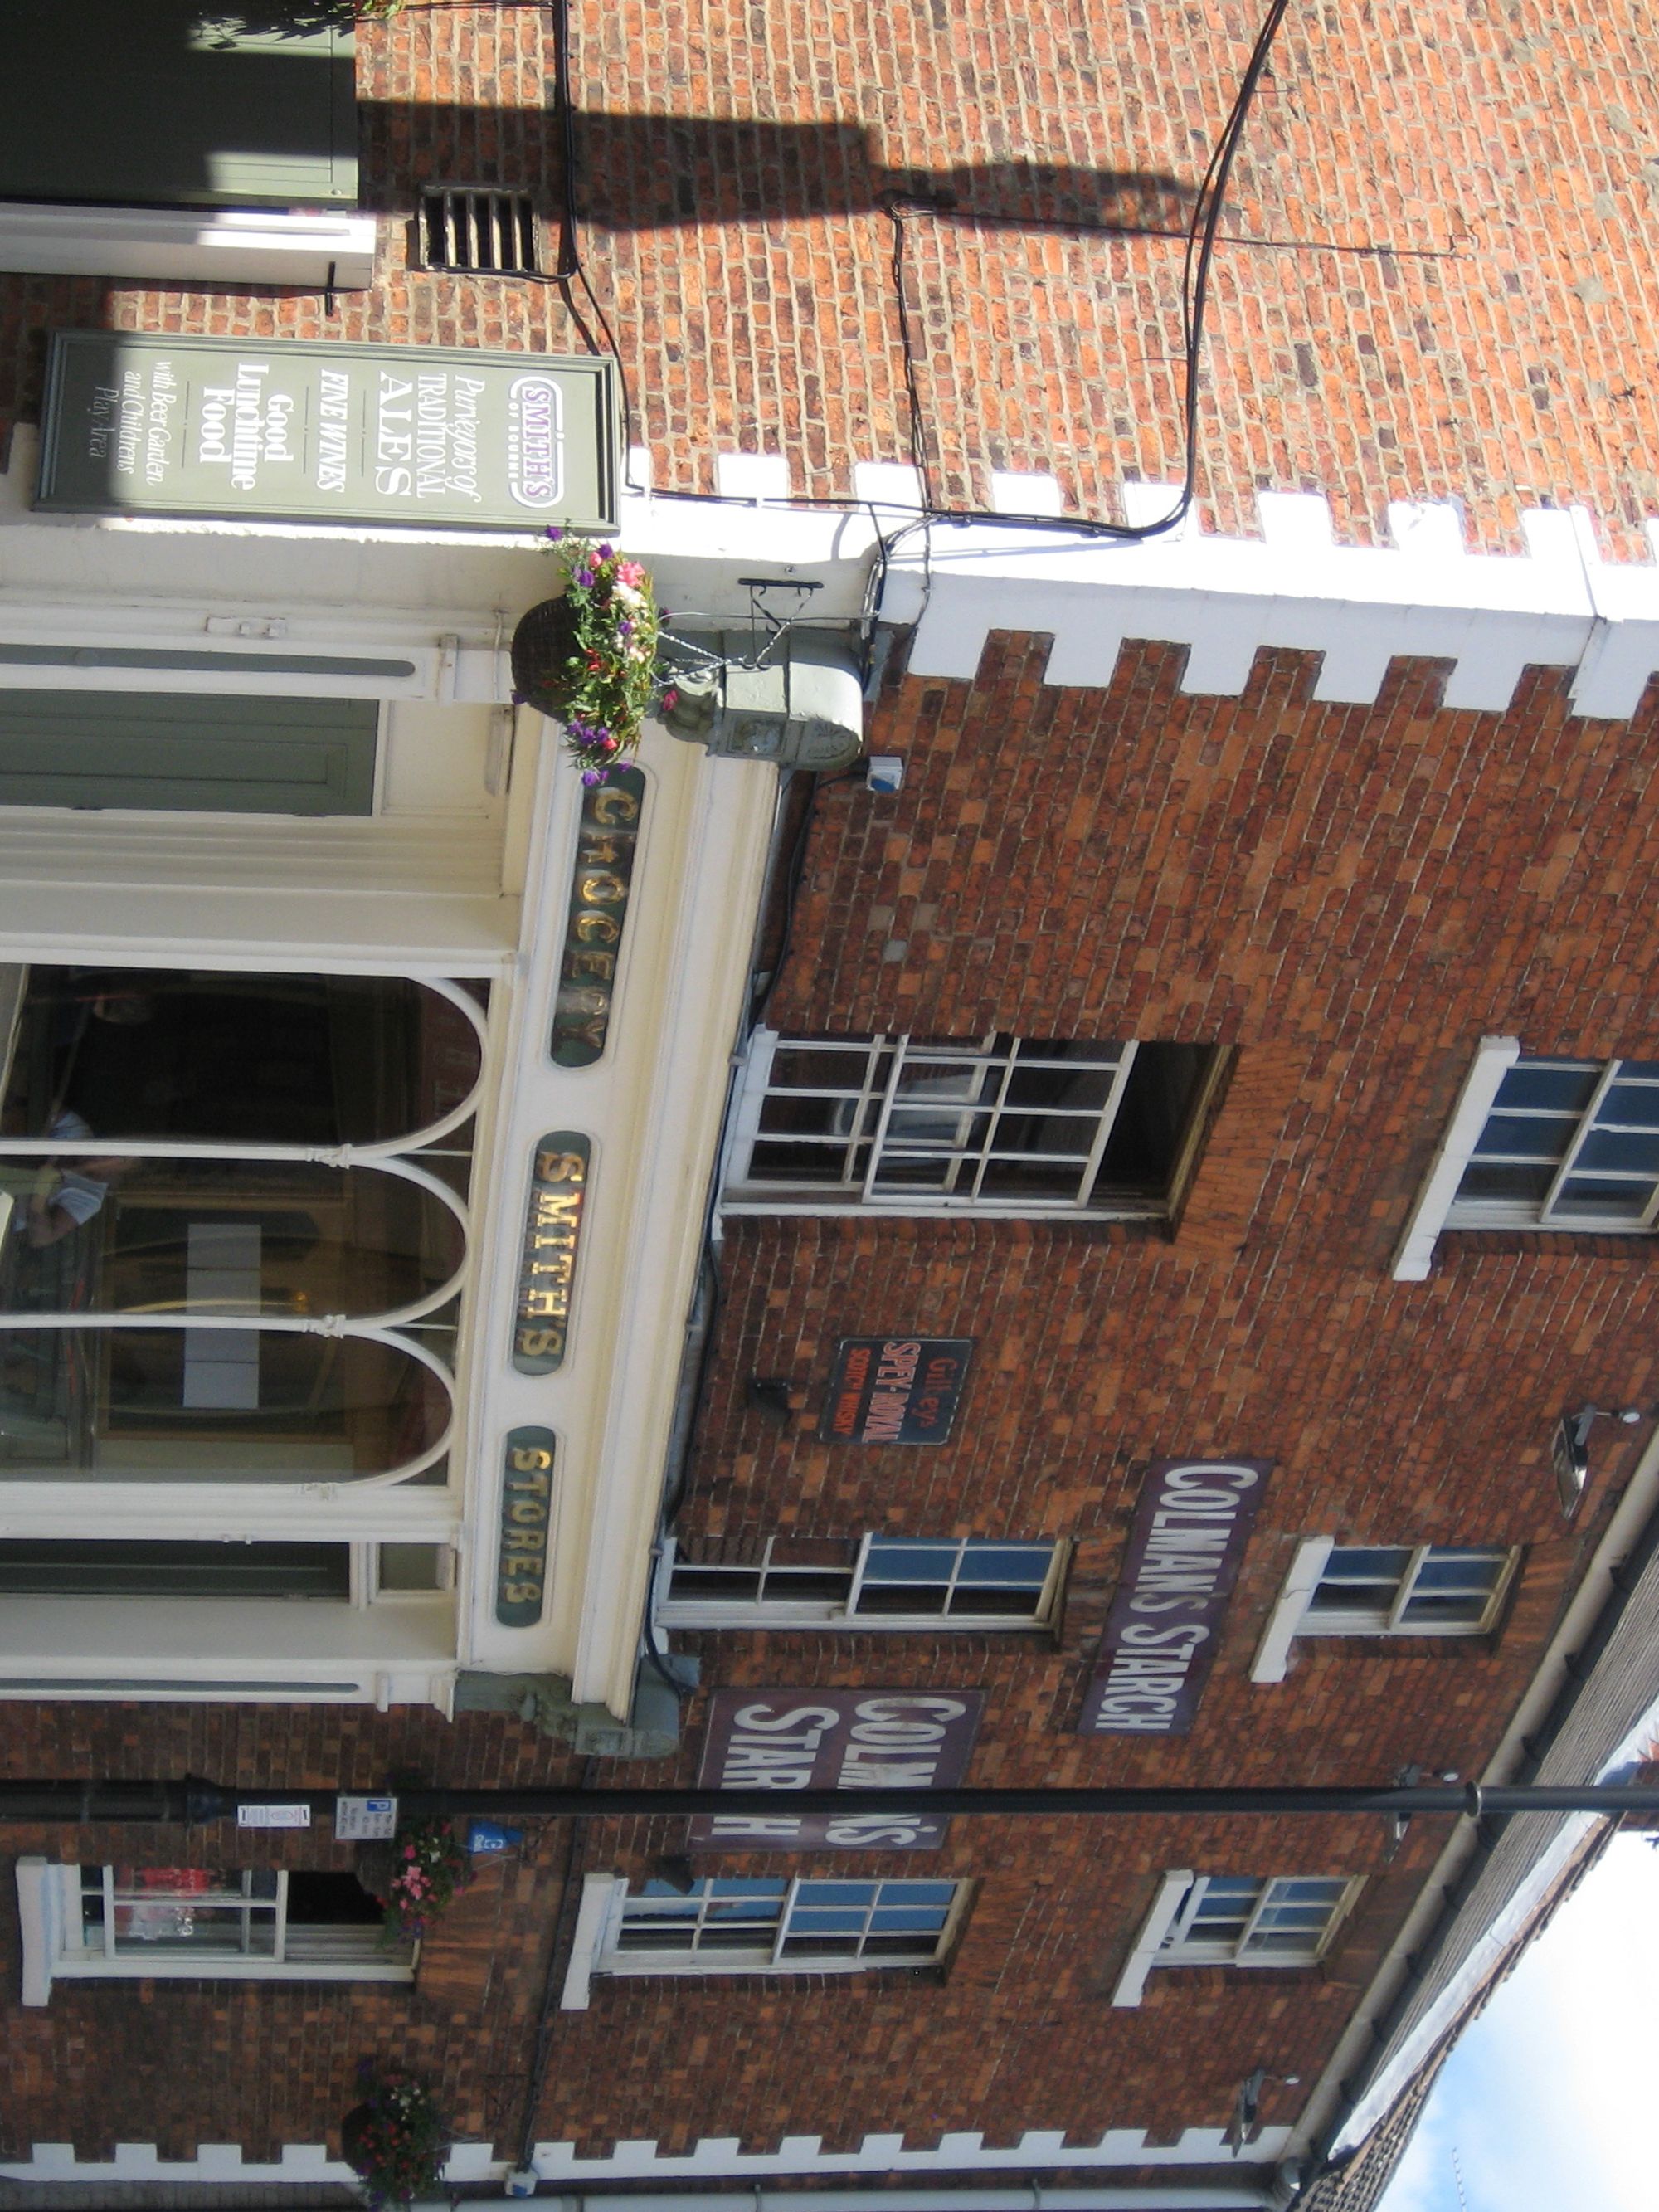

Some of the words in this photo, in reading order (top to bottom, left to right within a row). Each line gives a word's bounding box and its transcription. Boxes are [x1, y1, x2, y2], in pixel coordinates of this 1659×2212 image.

[87, 387, 119, 417] Play
[123, 372, 145, 400] and
[148, 391, 177, 427] Beer
[152, 361, 176, 390] with
[319, 369, 348, 421] FINE
[508, 403, 518, 417] OF
[89, 422, 115, 457] Area
[116, 400, 144, 474] Childrens
[145, 427, 172, 486] Garden
[199, 387, 235, 464] Food
[231, 363, 269, 490] Lunchtime
[264, 395, 294, 462] Good
[317, 421, 347, 492] WINES
[375, 371, 412, 496] ALES
[416, 373, 447, 498] TRADITIONAL
[445, 375, 485, 475] Purveyors
[508, 426, 519, 479] BOURNE
[522, 387, 554, 498] SMITH'S
[445, 475, 481, 503] of
[834, 1392, 862, 1436] WHISKY
[500, 1448, 551, 1603] STORES
[1094, 1624, 1210, 1730] STARCH
[711, 1704, 840, 1836] STARH
[825, 1697, 966, 1846] COLMN'S
